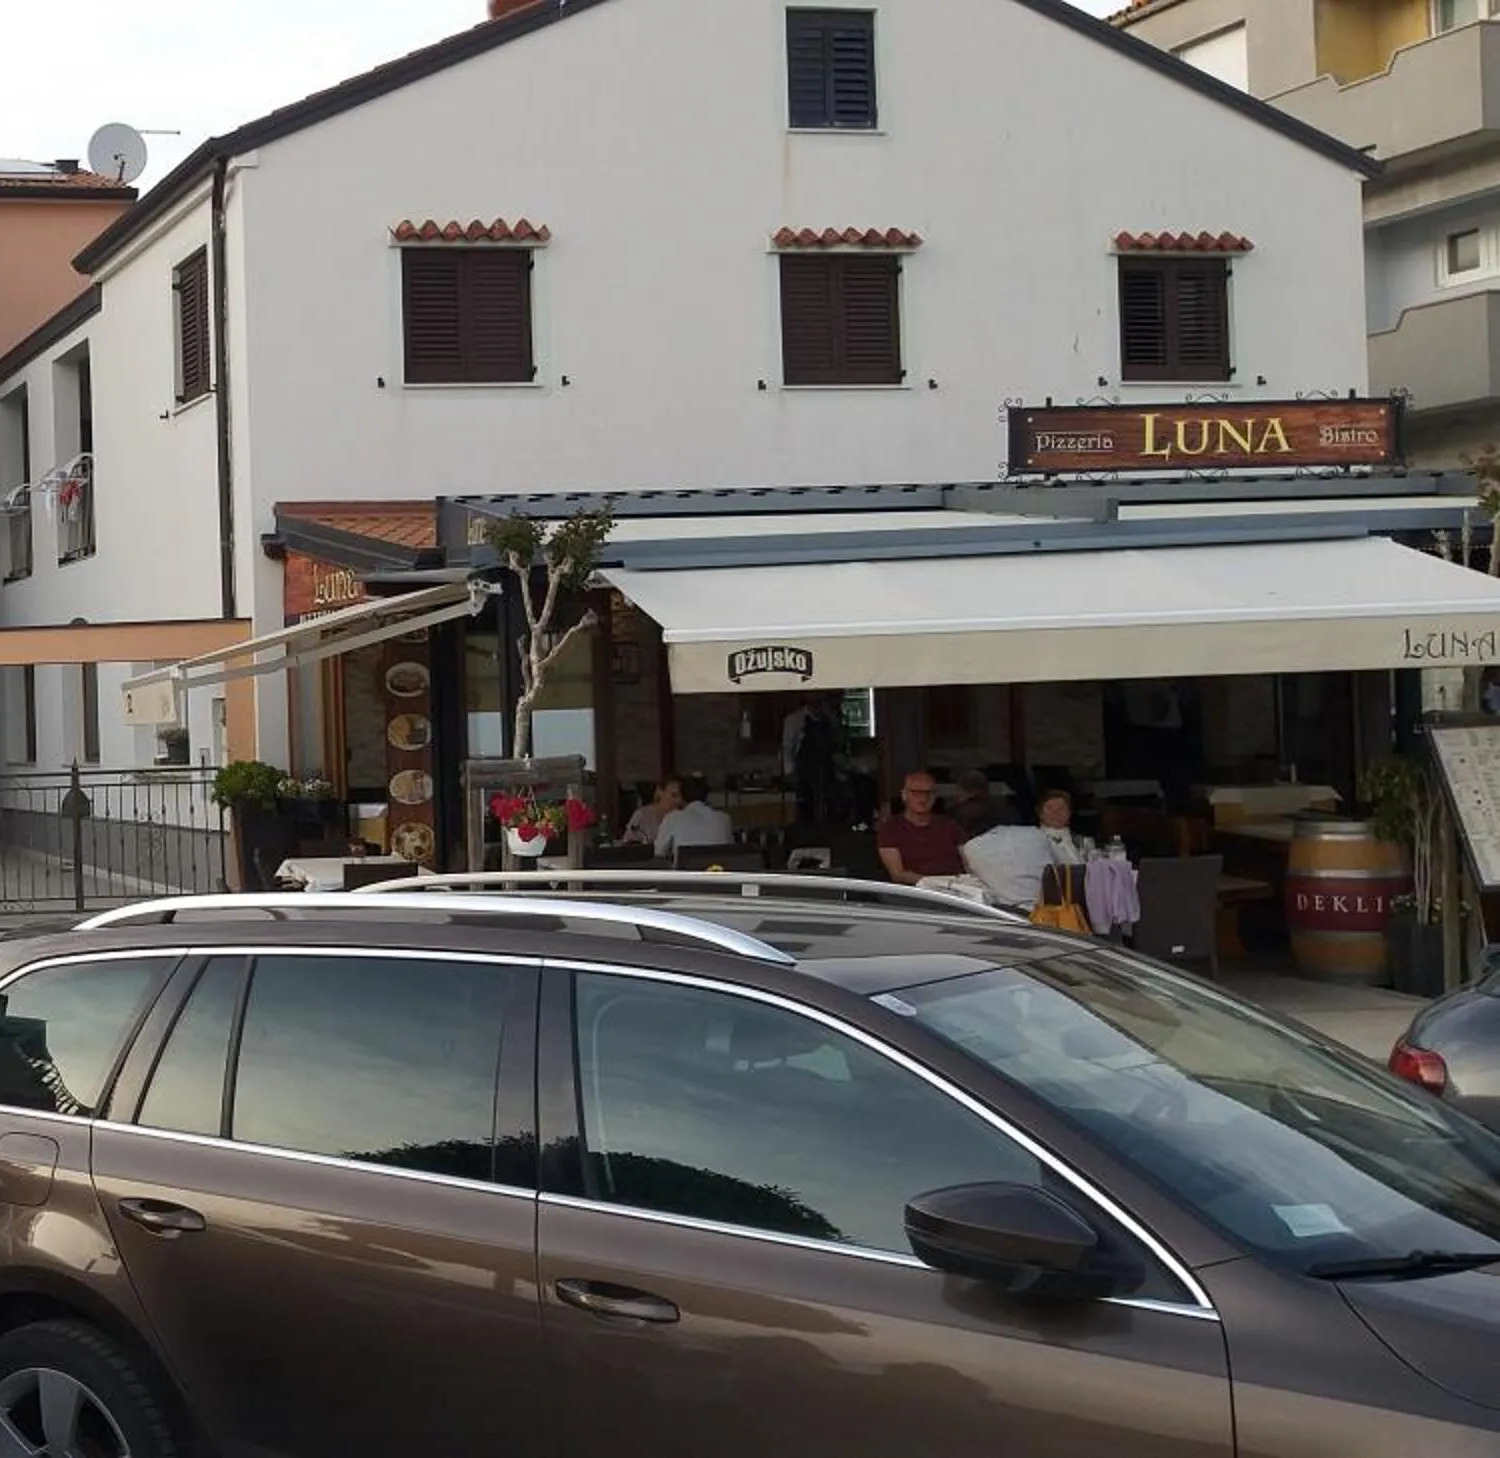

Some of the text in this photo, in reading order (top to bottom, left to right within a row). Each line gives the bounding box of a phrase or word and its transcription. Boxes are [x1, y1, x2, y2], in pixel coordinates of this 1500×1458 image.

[1035, 412, 1379, 462] Pizzeria LUNA Bistro
[1403, 628, 1496, 661] LUNA
